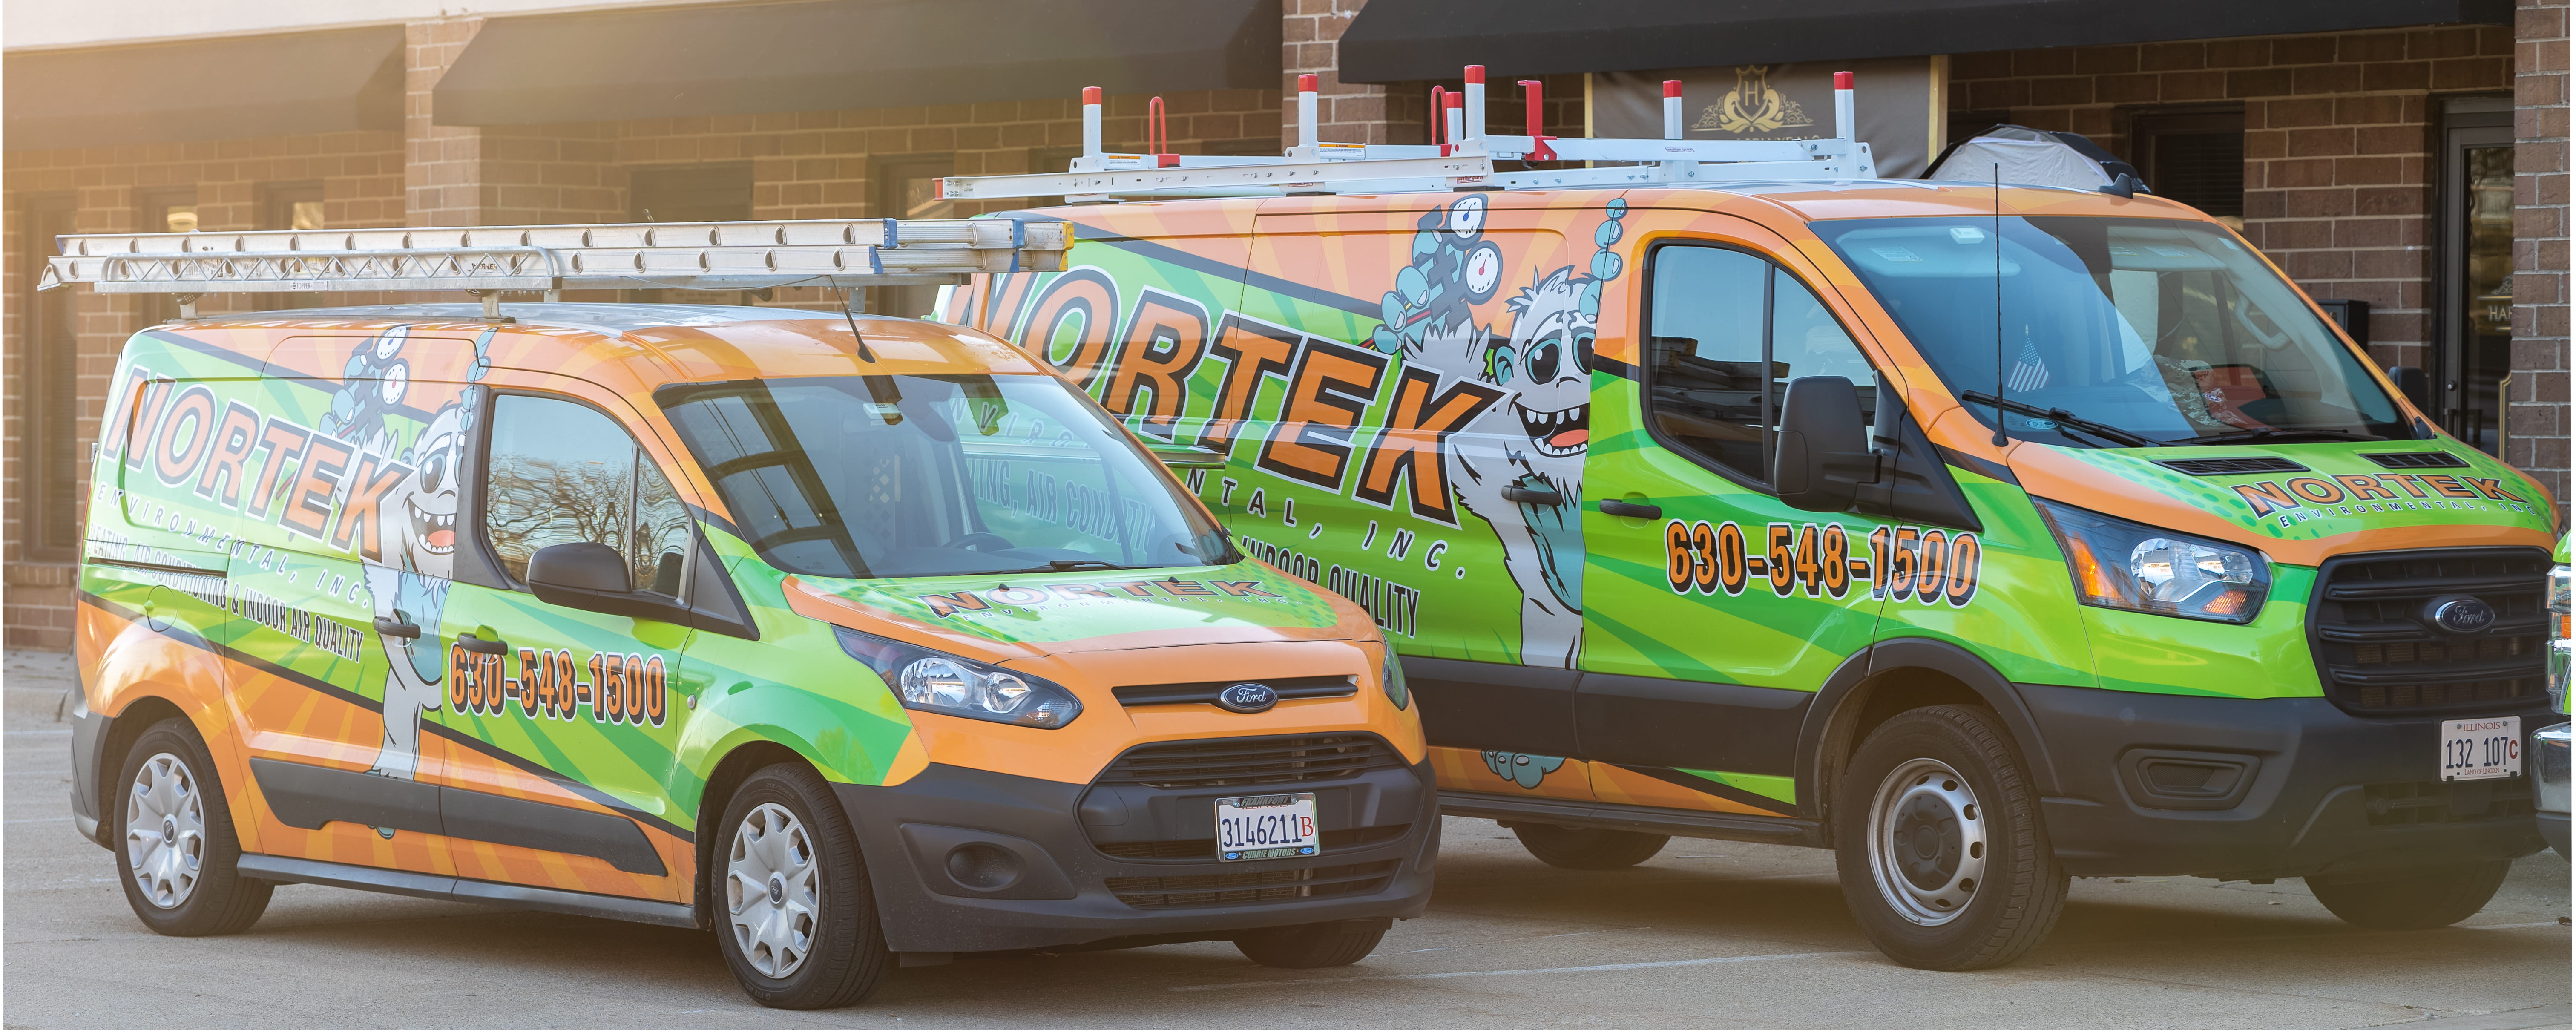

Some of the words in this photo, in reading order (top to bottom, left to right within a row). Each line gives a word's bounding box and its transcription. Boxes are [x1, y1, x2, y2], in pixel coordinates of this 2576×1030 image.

[98, 364, 418, 564] NORTEK
[2229, 473, 2530, 520] NORTEK
[2279, 501, 2487, 529] ENVIRONMENTAL,
[97, 483, 297, 582] ENVIRONMENTAL,
[315, 569, 369, 609] INC.
[1361, 520, 1465, 580] INC.
[1664, 519, 1982, 609] 630-548-1500
[920, 580, 1286, 619] NORTEK
[1241, 596, 1302, 605] INC.
[2453, 605, 2485, 625] Ford
[231, 582, 240, 616] &
[243, 586, 287, 634] INDOOR
[290, 605, 310, 644] AIR
[314, 613, 364, 664] QUALITY
[450, 642, 667, 729] 630-548-1500
[1236, 688, 1266, 704] Ford
[2463, 722, 2501, 731] ILLINOIS
[2446, 738, 2473, 769] 132
[1240, 795, 1291, 807] FRANKFORT
[1242, 849, 1268, 860] CURRIE
[1267, 848, 1296, 859] MOTORS
